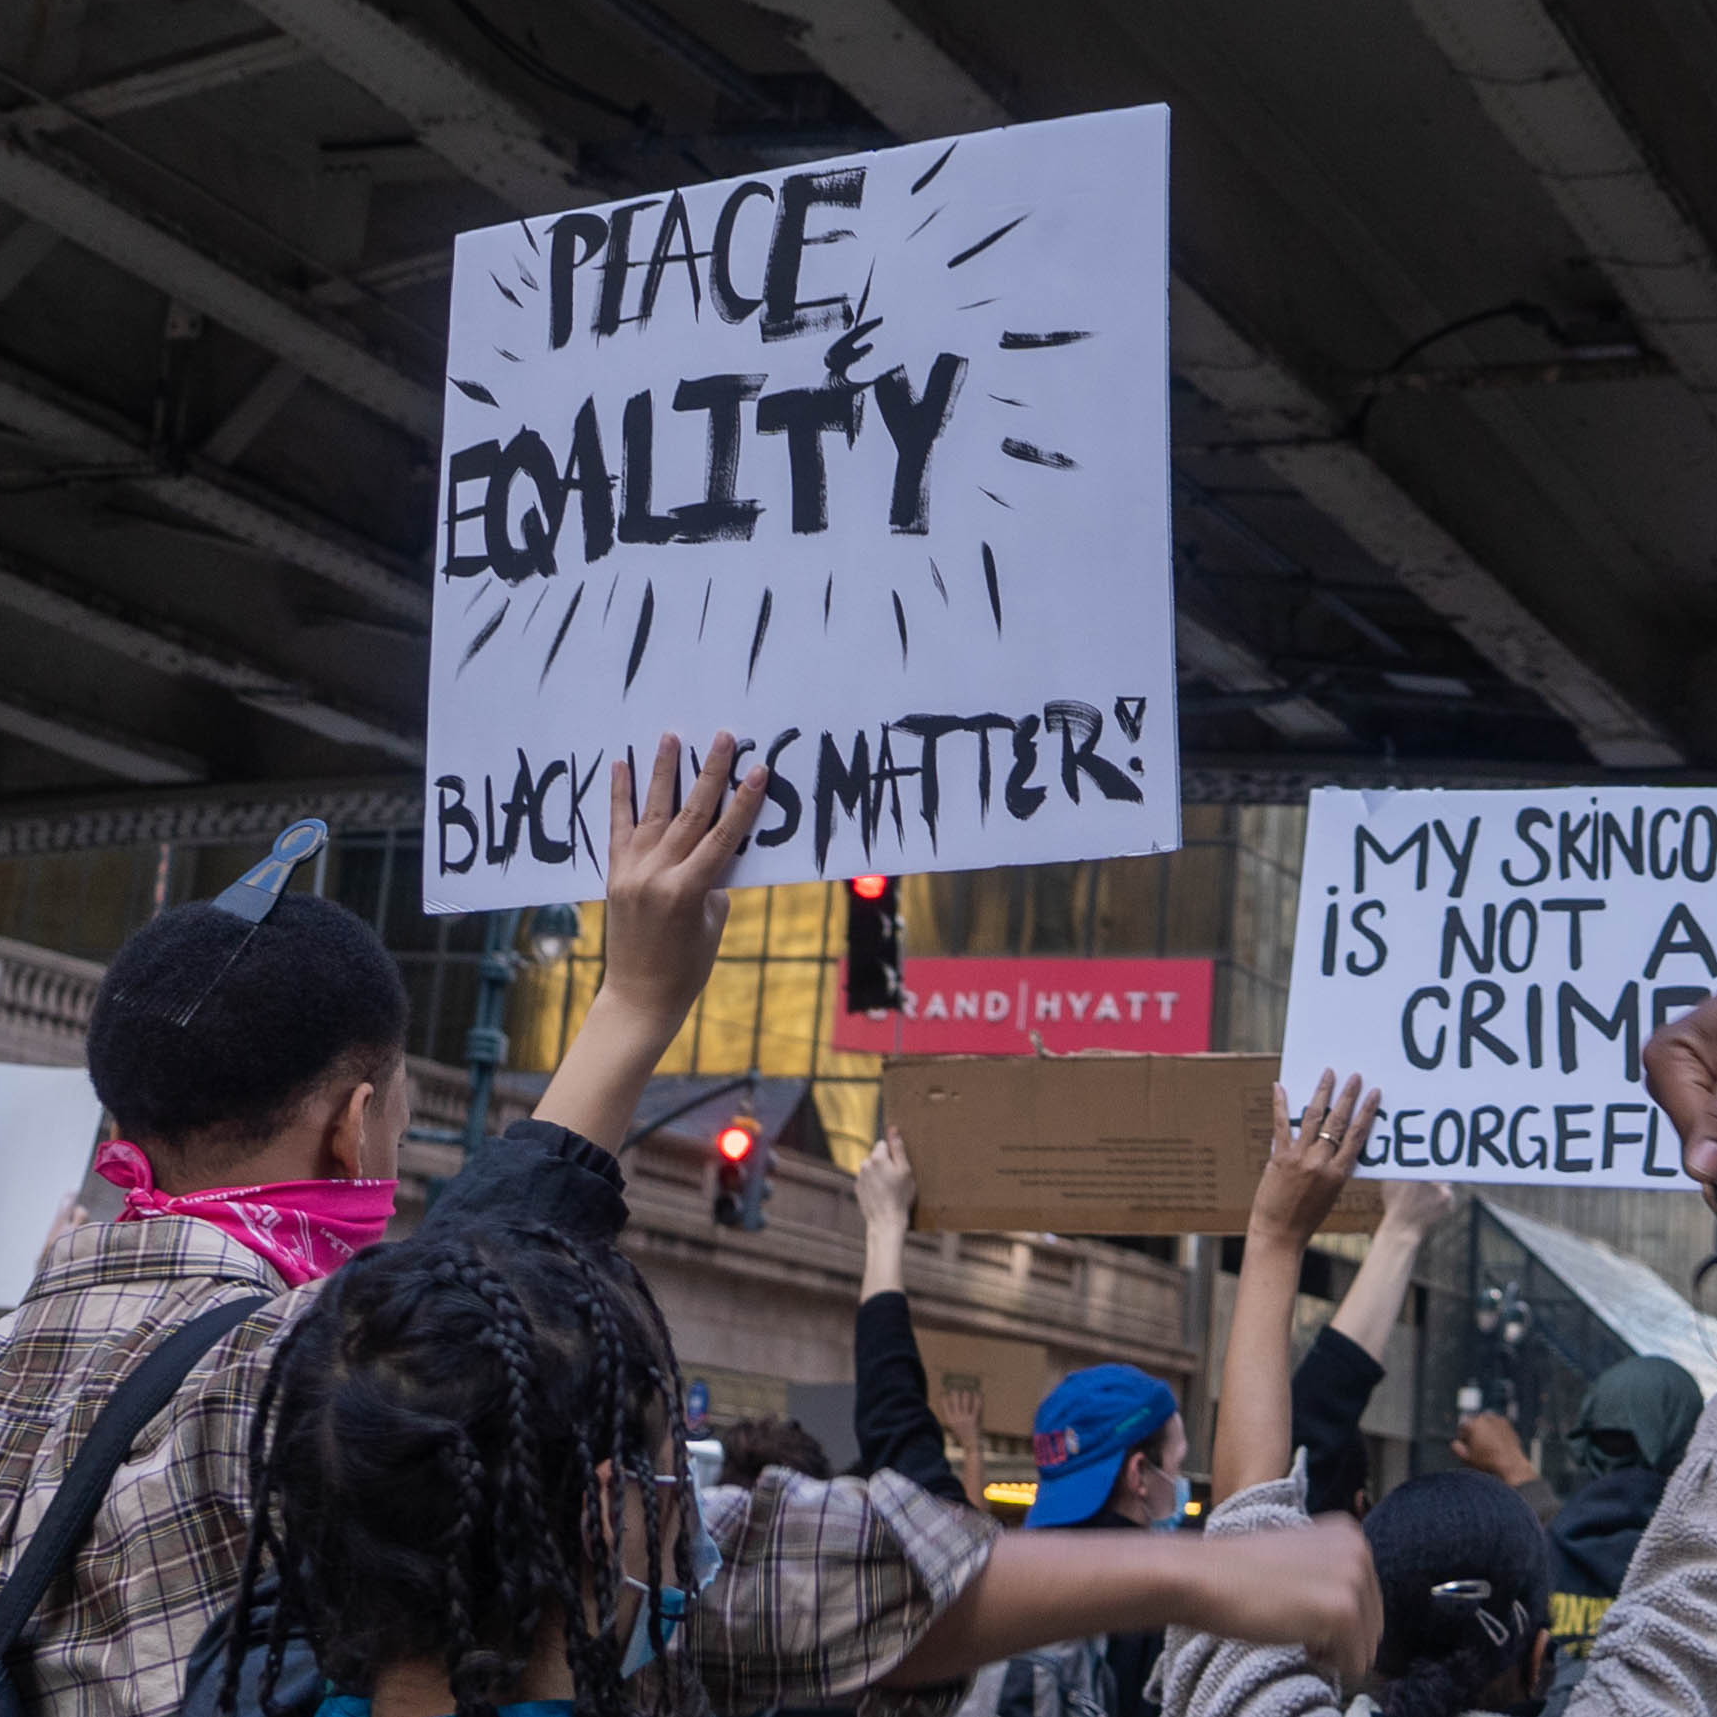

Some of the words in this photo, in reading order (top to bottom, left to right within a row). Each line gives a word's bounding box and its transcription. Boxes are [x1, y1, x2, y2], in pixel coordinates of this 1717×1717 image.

[542, 166, 869, 352] PEACE
[439, 351, 970, 587] EQALITY
[435, 746, 604, 879] BLACK
[813, 696, 1148, 877] MATTER!
[1354, 816, 1481, 899] MY
[1439, 897, 1607, 980] NOT
[867, 990, 1011, 1023] RAND
[1034, 990, 1180, 1023] HYATT
[1289, 1104, 1679, 1178] GEORGEFL
